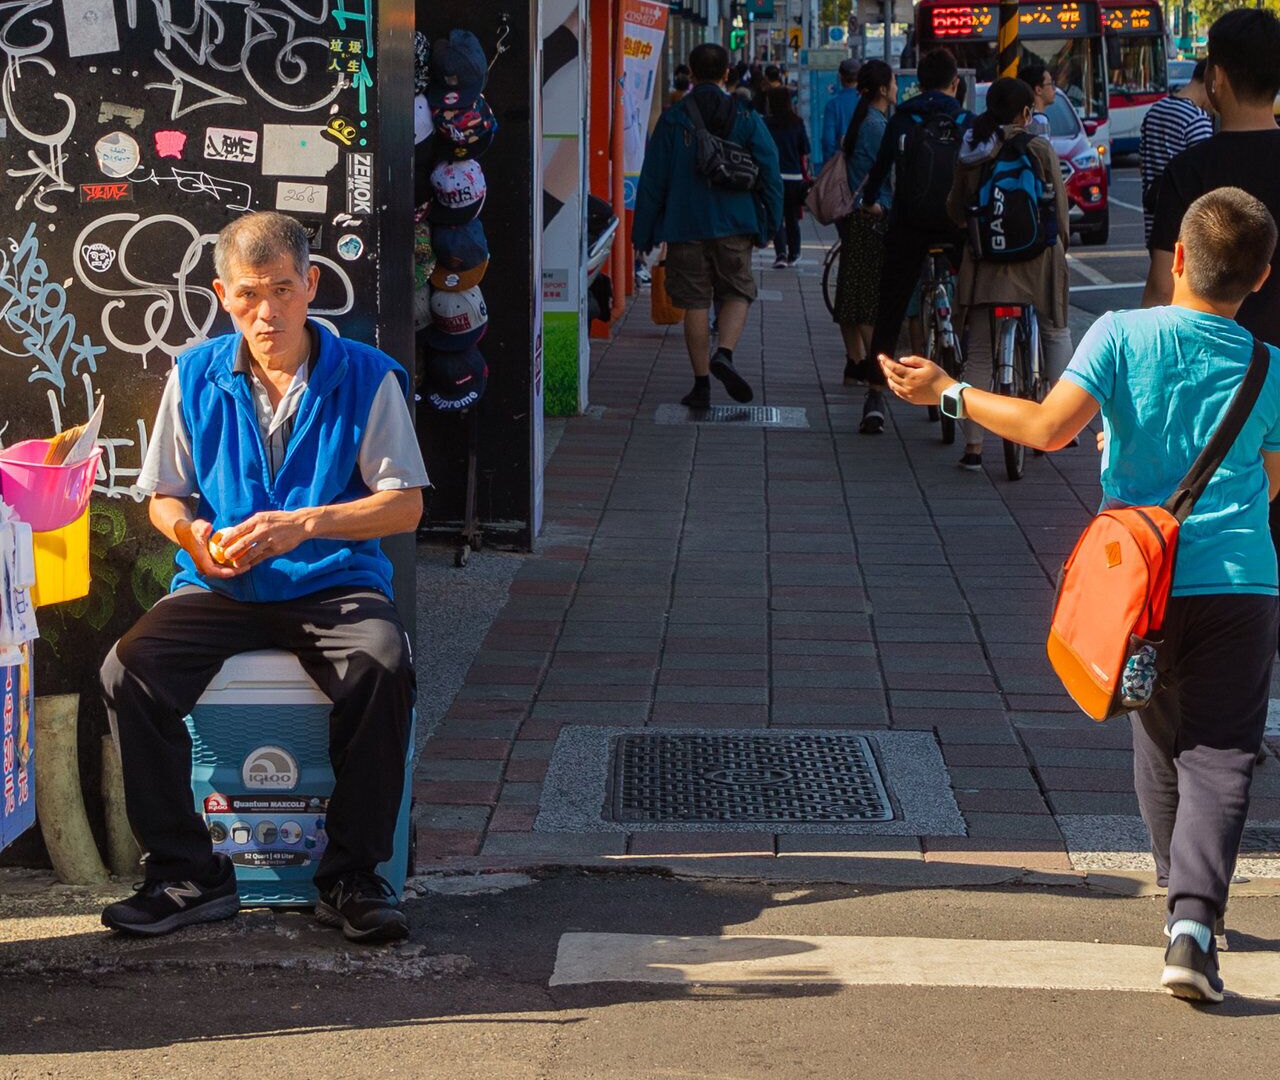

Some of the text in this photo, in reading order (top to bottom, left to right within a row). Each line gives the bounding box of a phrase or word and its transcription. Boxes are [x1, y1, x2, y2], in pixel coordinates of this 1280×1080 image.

[328, 59, 361, 73] 人生
[353, 153, 371, 213] ZEMOK
[233, 800, 269, 809] Quantum
[252, 853, 270, 861] Quart
